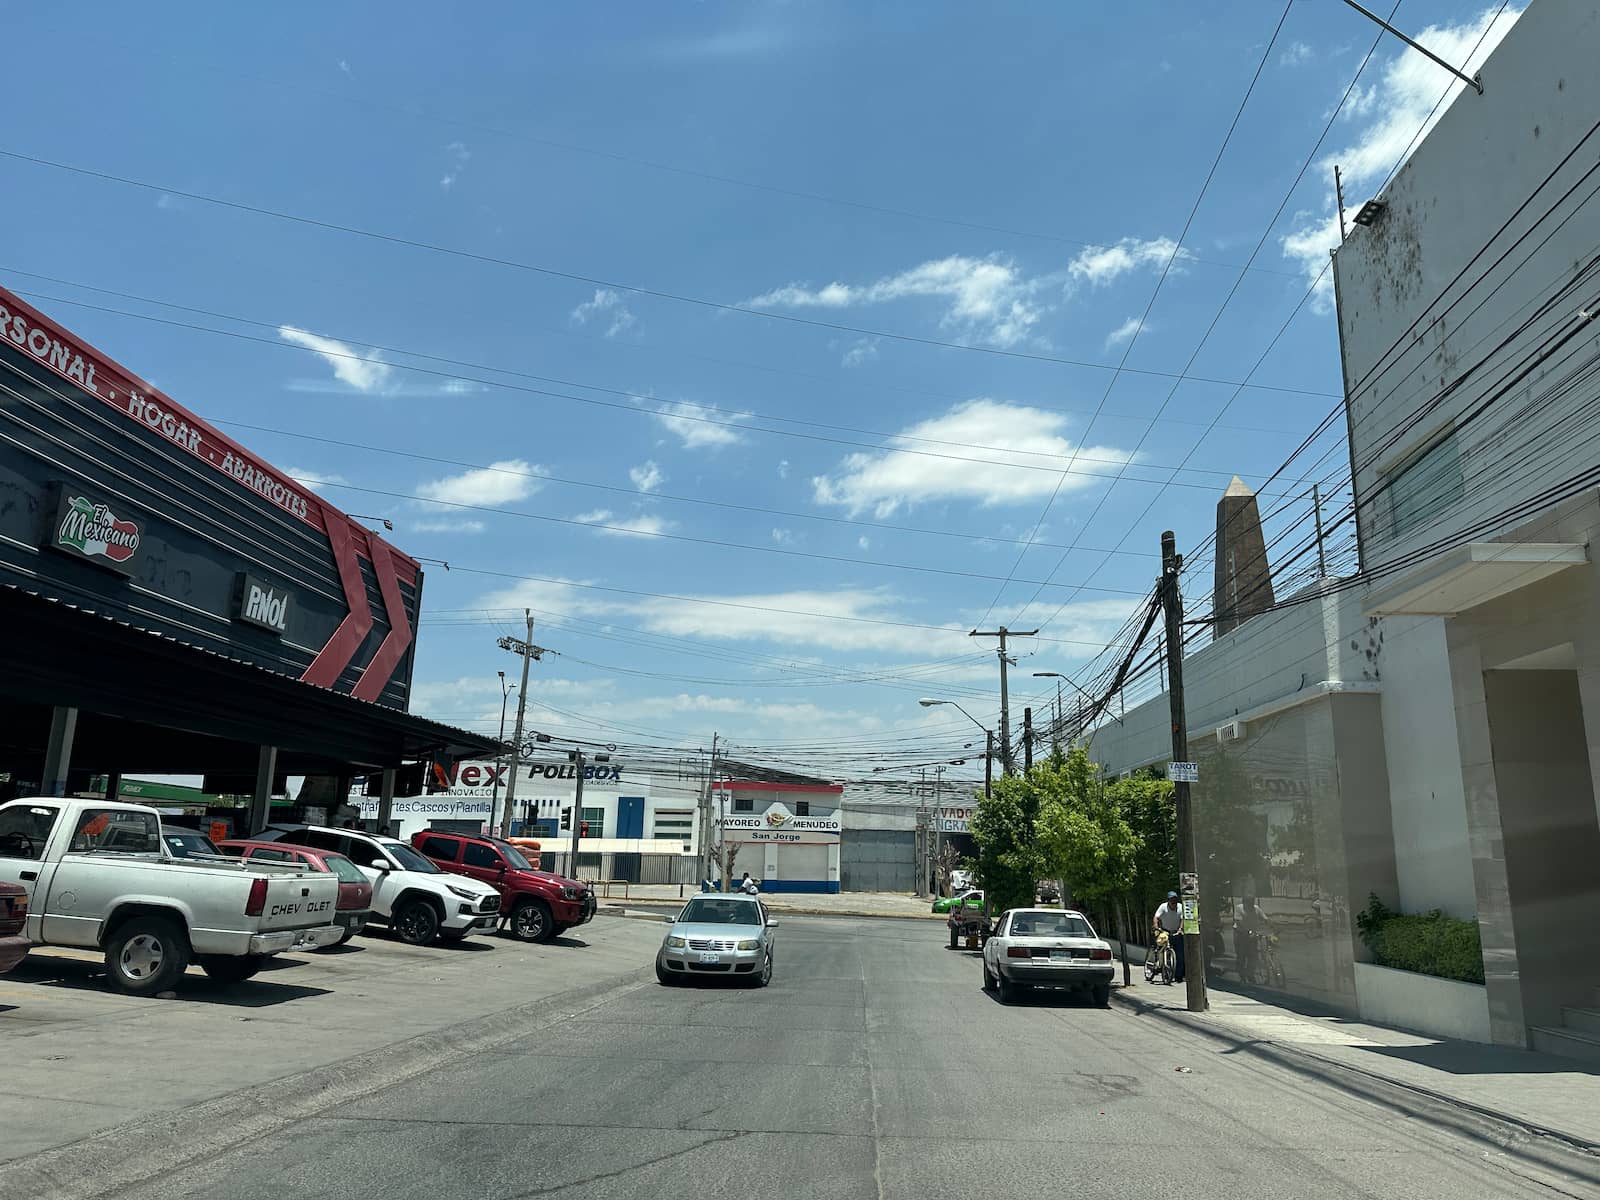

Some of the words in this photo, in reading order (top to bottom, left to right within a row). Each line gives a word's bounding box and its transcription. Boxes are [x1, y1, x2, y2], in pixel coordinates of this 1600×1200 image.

[127, 390, 202, 454] HOGAR
[220, 451, 308, 518] ABARROTES
[93, 505, 107, 524] El
[60, 509, 140, 550] Mexicano
[528, 765, 624, 779] POLLBOX
[1168, 762, 1198, 770] TAROT
[411, 801, 449, 812] Cascos
[449, 804, 456, 815] y
[924, 807, 972, 819] AVADO
[715, 818, 761, 827] MAYOREO
[793, 821, 839, 829] MENUDEO
[752, 832, 770, 840] San
[773, 833, 801, 841] Jorge
